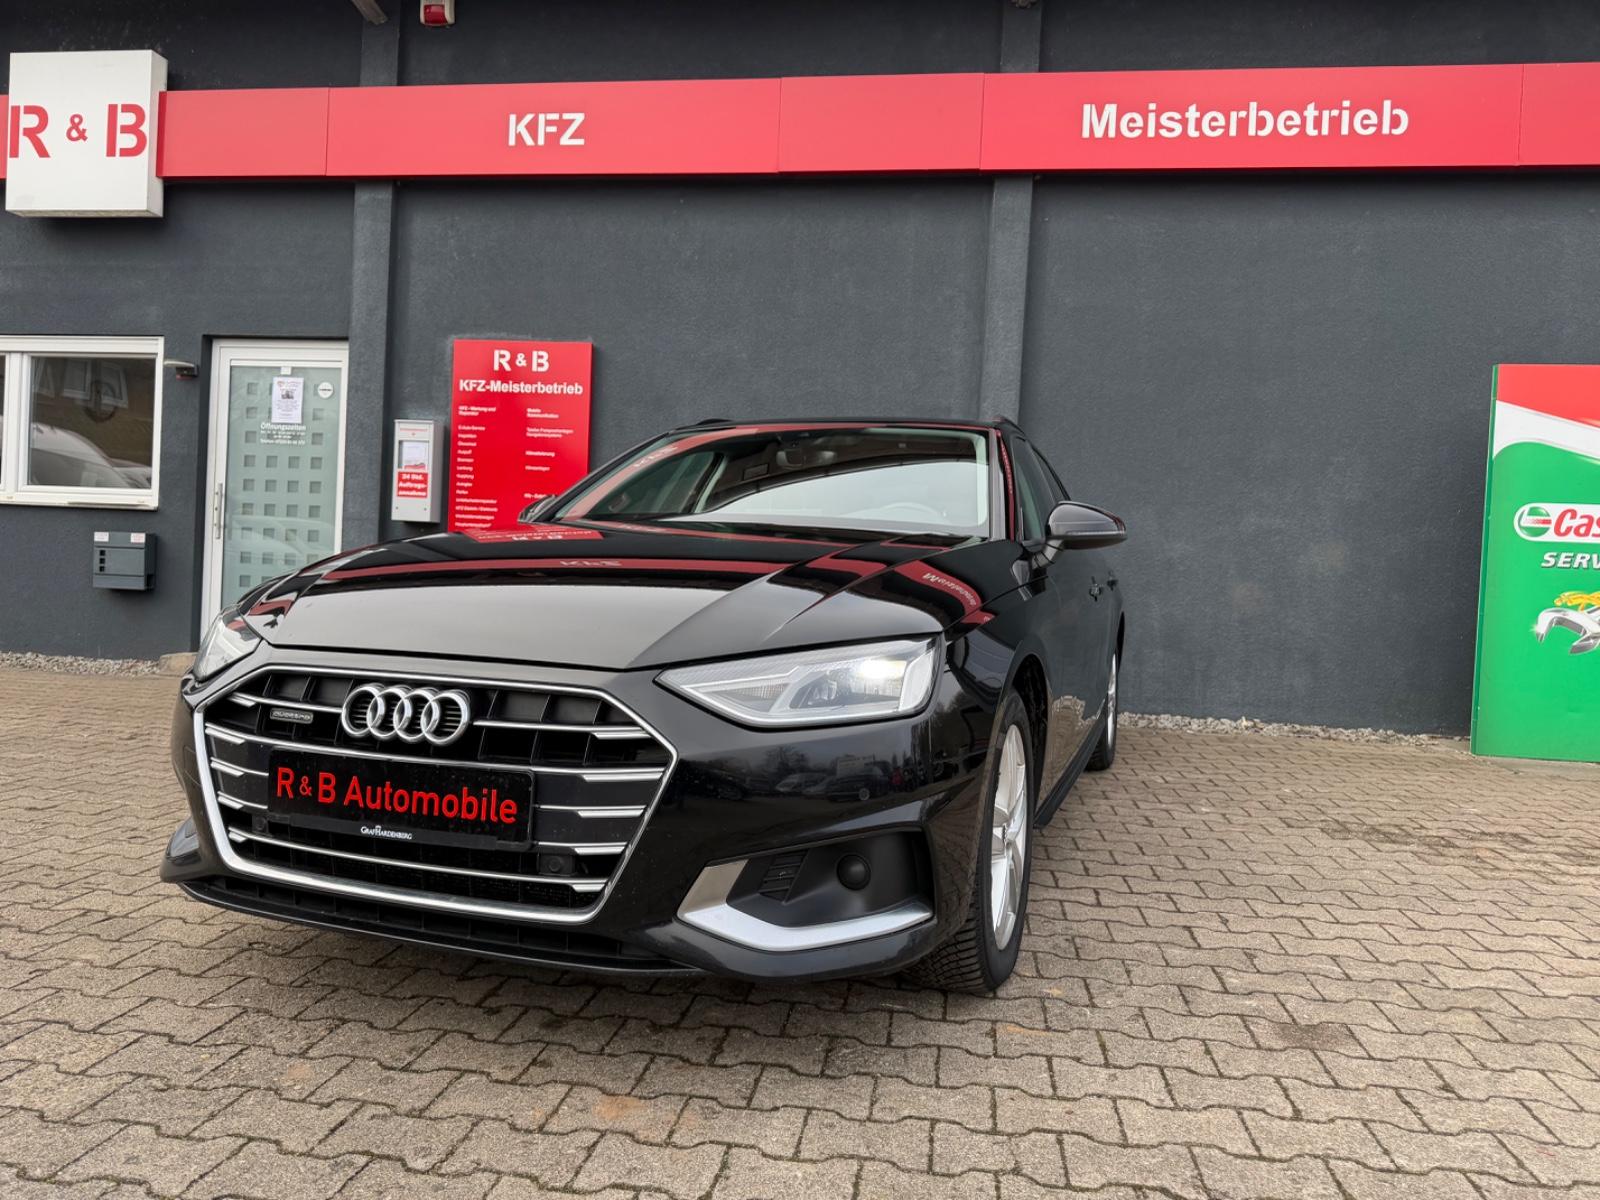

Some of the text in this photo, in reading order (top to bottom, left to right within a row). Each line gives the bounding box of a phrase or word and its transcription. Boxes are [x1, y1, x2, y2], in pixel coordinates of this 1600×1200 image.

[9, 104, 147, 158] R & B
[508, 113, 585, 146] KFZ
[1081, 100, 1409, 138] Meisterbetrieb
[493, 349, 550, 372] R & B
[459, 379, 583, 395] KFZ-Meisterbetrieb
[277, 767, 518, 824] R & B Automobile
